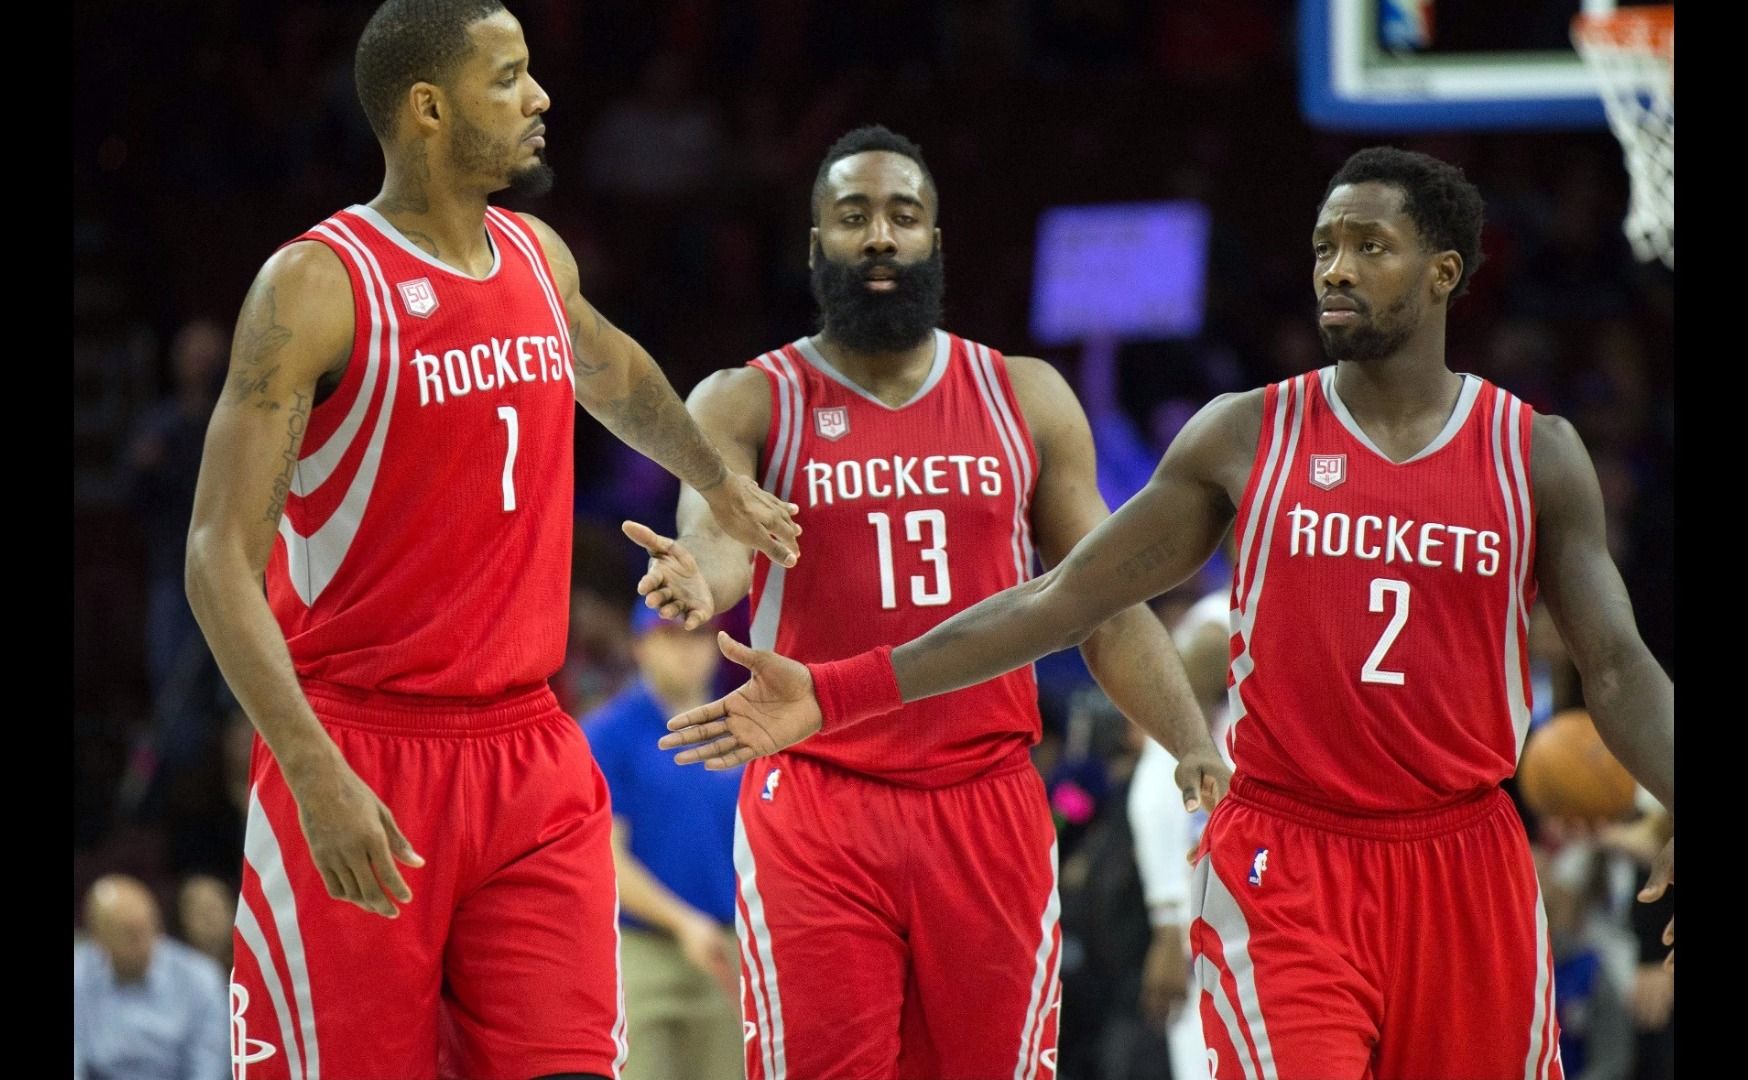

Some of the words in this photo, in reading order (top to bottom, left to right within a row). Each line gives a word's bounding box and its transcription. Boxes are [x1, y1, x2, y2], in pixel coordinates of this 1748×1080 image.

[407, 283, 429, 304] 50
[409, 335, 563, 408] ROCKETS
[820, 410, 843, 427] 50
[497, 406, 519, 512] 1
[803, 454, 1003, 508] ROCKETS
[1316, 459, 1339, 475] 50
[866, 508, 952, 609] 13
[1287, 502, 1501, 577] ROCKETS
[1360, 577, 1411, 685] 2
